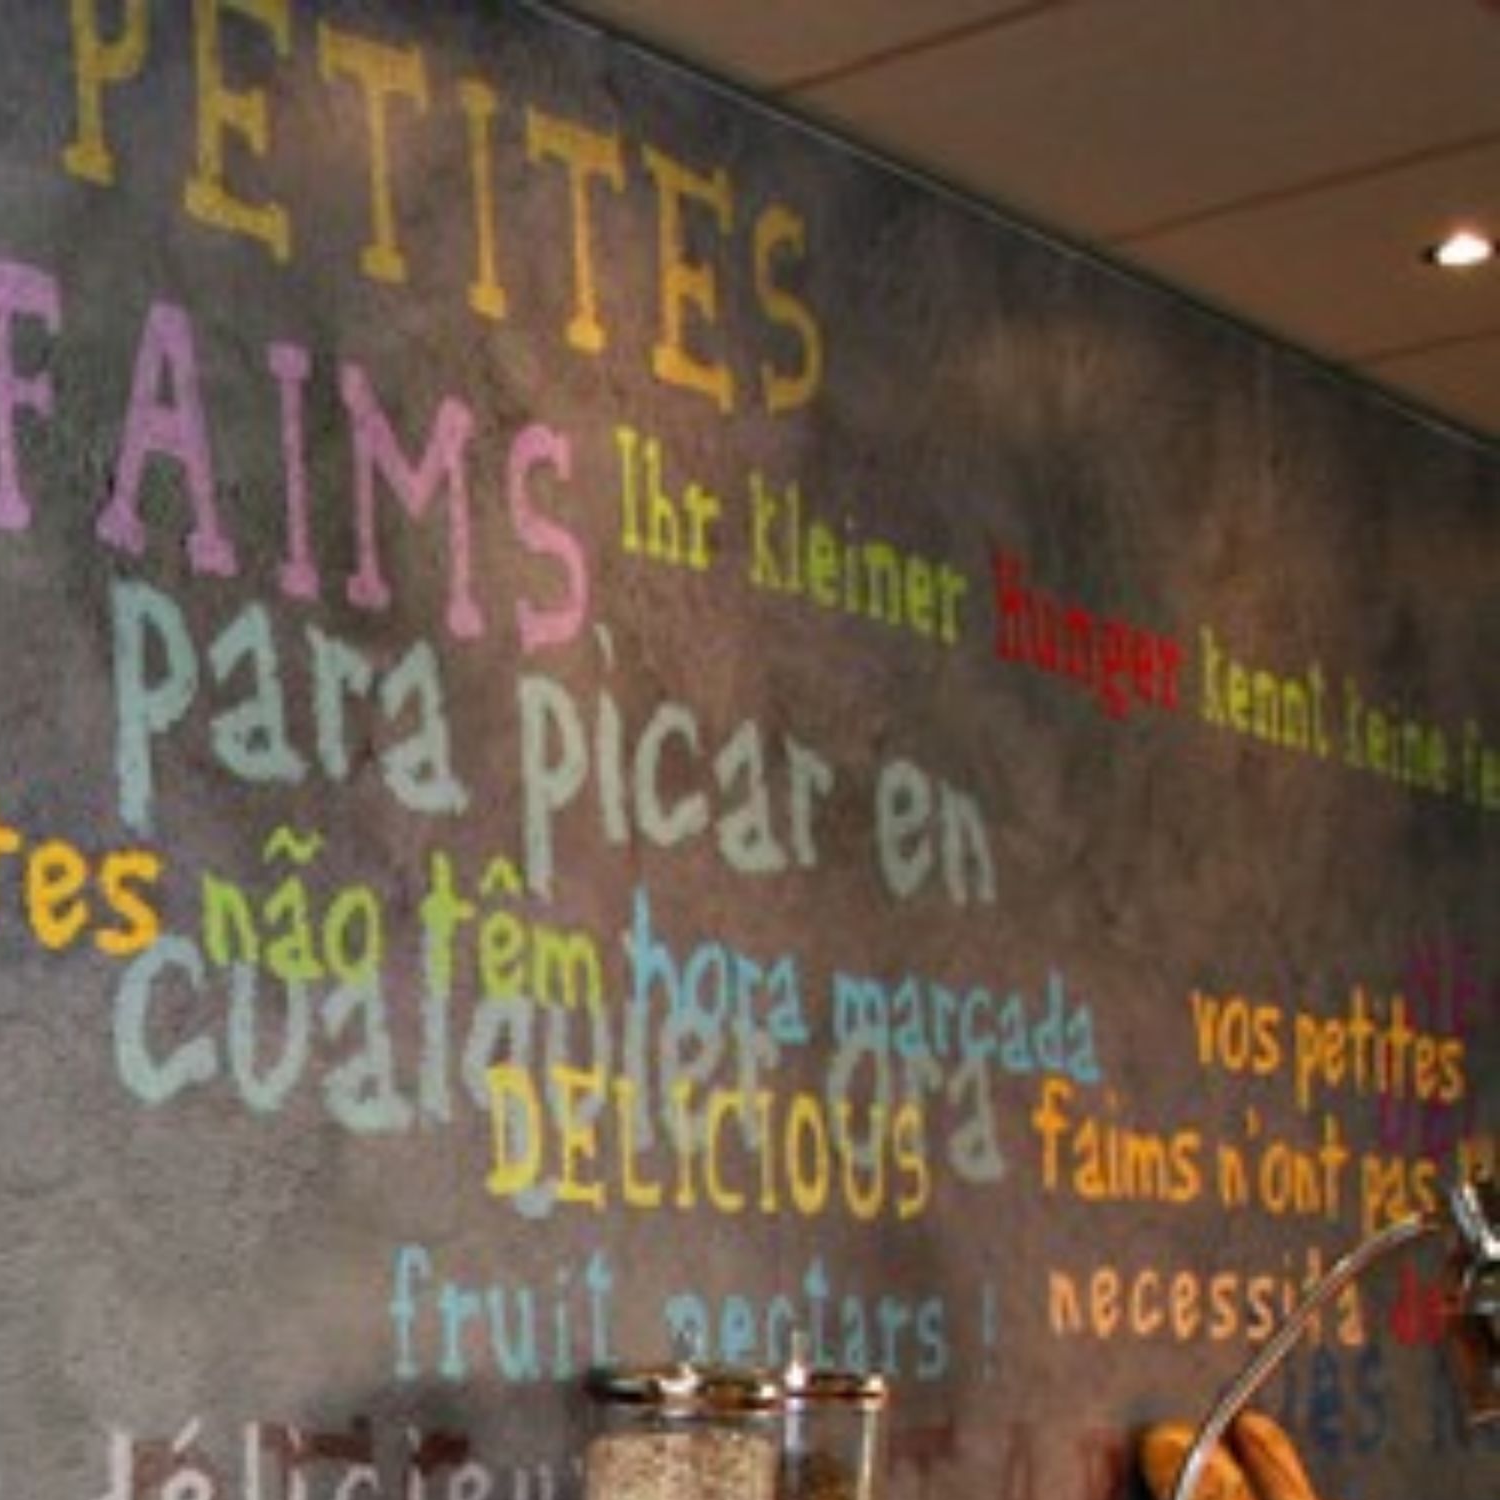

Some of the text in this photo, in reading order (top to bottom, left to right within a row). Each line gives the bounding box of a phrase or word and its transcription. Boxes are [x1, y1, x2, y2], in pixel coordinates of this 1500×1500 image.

[62, 0, 826, 412] PETITES
[614, 424, 722, 572] Ihr
[748, 470, 968, 648] kleiner
[110, 576, 998, 906] para picar en
[200, 824, 382, 988] não
[428, 848, 606, 1014] têm
[620, 880, 808, 1048] hora
[486, 1062, 932, 1220] DELICIOUS
[1186, 984, 1286, 1080] vos
[1294, 980, 1466, 1116] petites
[1032, 1076, 1204, 1206] faims
[1216, 1104, 1350, 1222] n'ont
[390, 1240, 618, 1382] fruit
